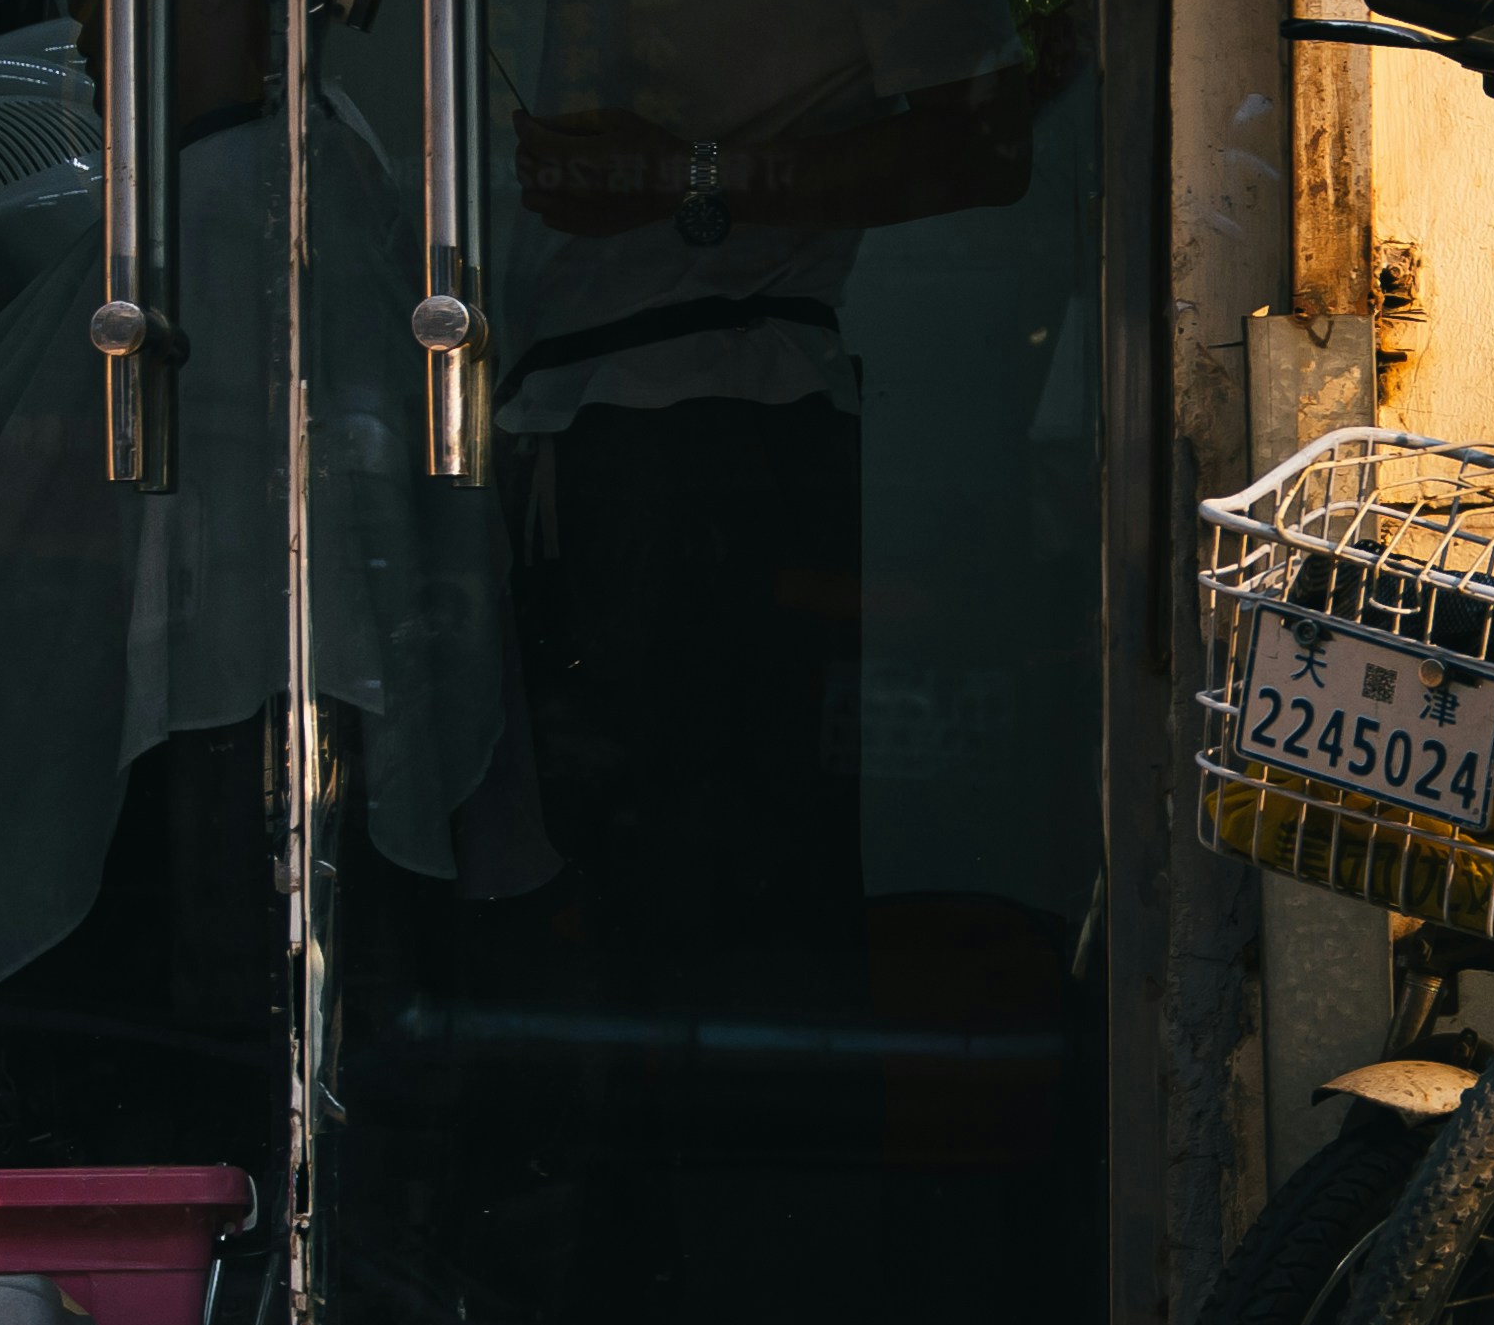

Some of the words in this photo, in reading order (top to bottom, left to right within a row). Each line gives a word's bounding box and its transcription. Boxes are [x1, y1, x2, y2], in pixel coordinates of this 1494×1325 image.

[1290, 645, 1328, 689] 天
[1419, 685, 1460, 728] 津
[1250, 685, 1480, 810] 2245024
